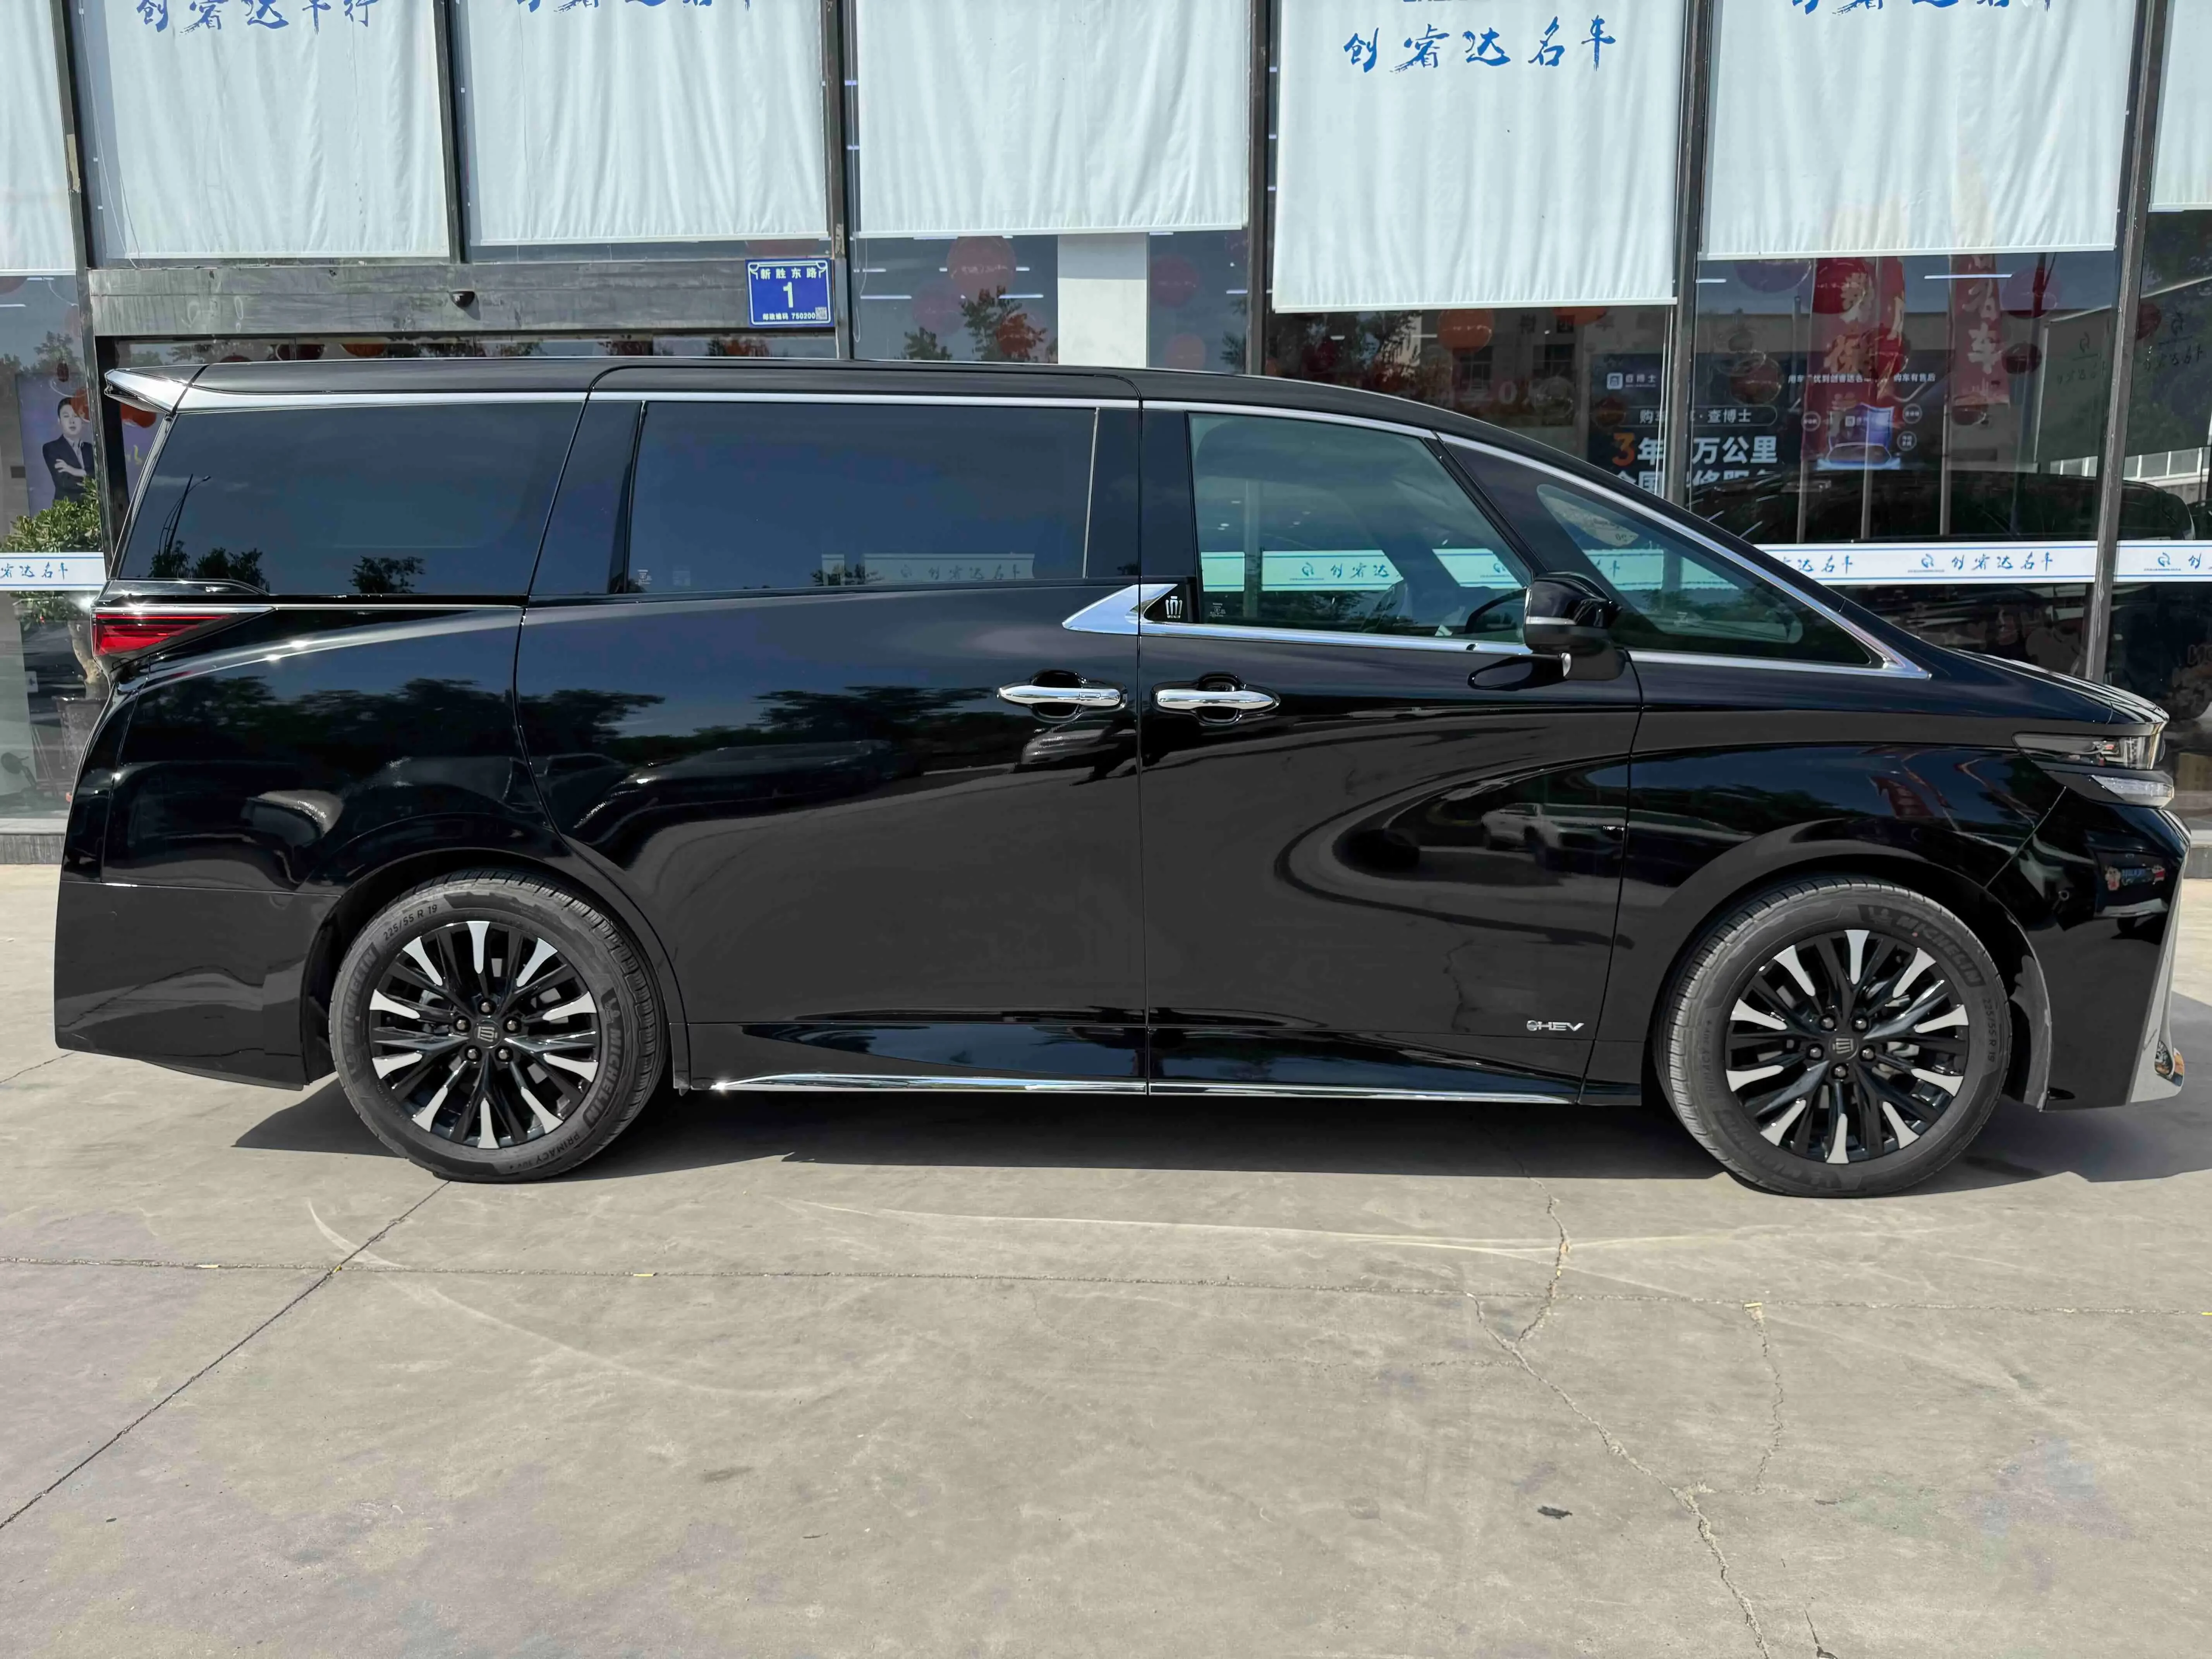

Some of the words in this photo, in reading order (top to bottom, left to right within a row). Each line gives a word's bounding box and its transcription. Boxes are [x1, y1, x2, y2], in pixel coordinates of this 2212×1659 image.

[1343, 15, 1616, 73] 创睿达名车
[761, 267, 817, 279] 新胜东路
[783, 282, 793, 308] 1
[1951, 551, 2053, 571] 创睿达名车
[383, 914, 414, 941] 225/55
[417, 909, 424, 918] R
[428, 904, 438, 914] 19
[588, 1029, 622, 1123] MICHELIN
[536, 1131, 580, 1164] PRIMACY
